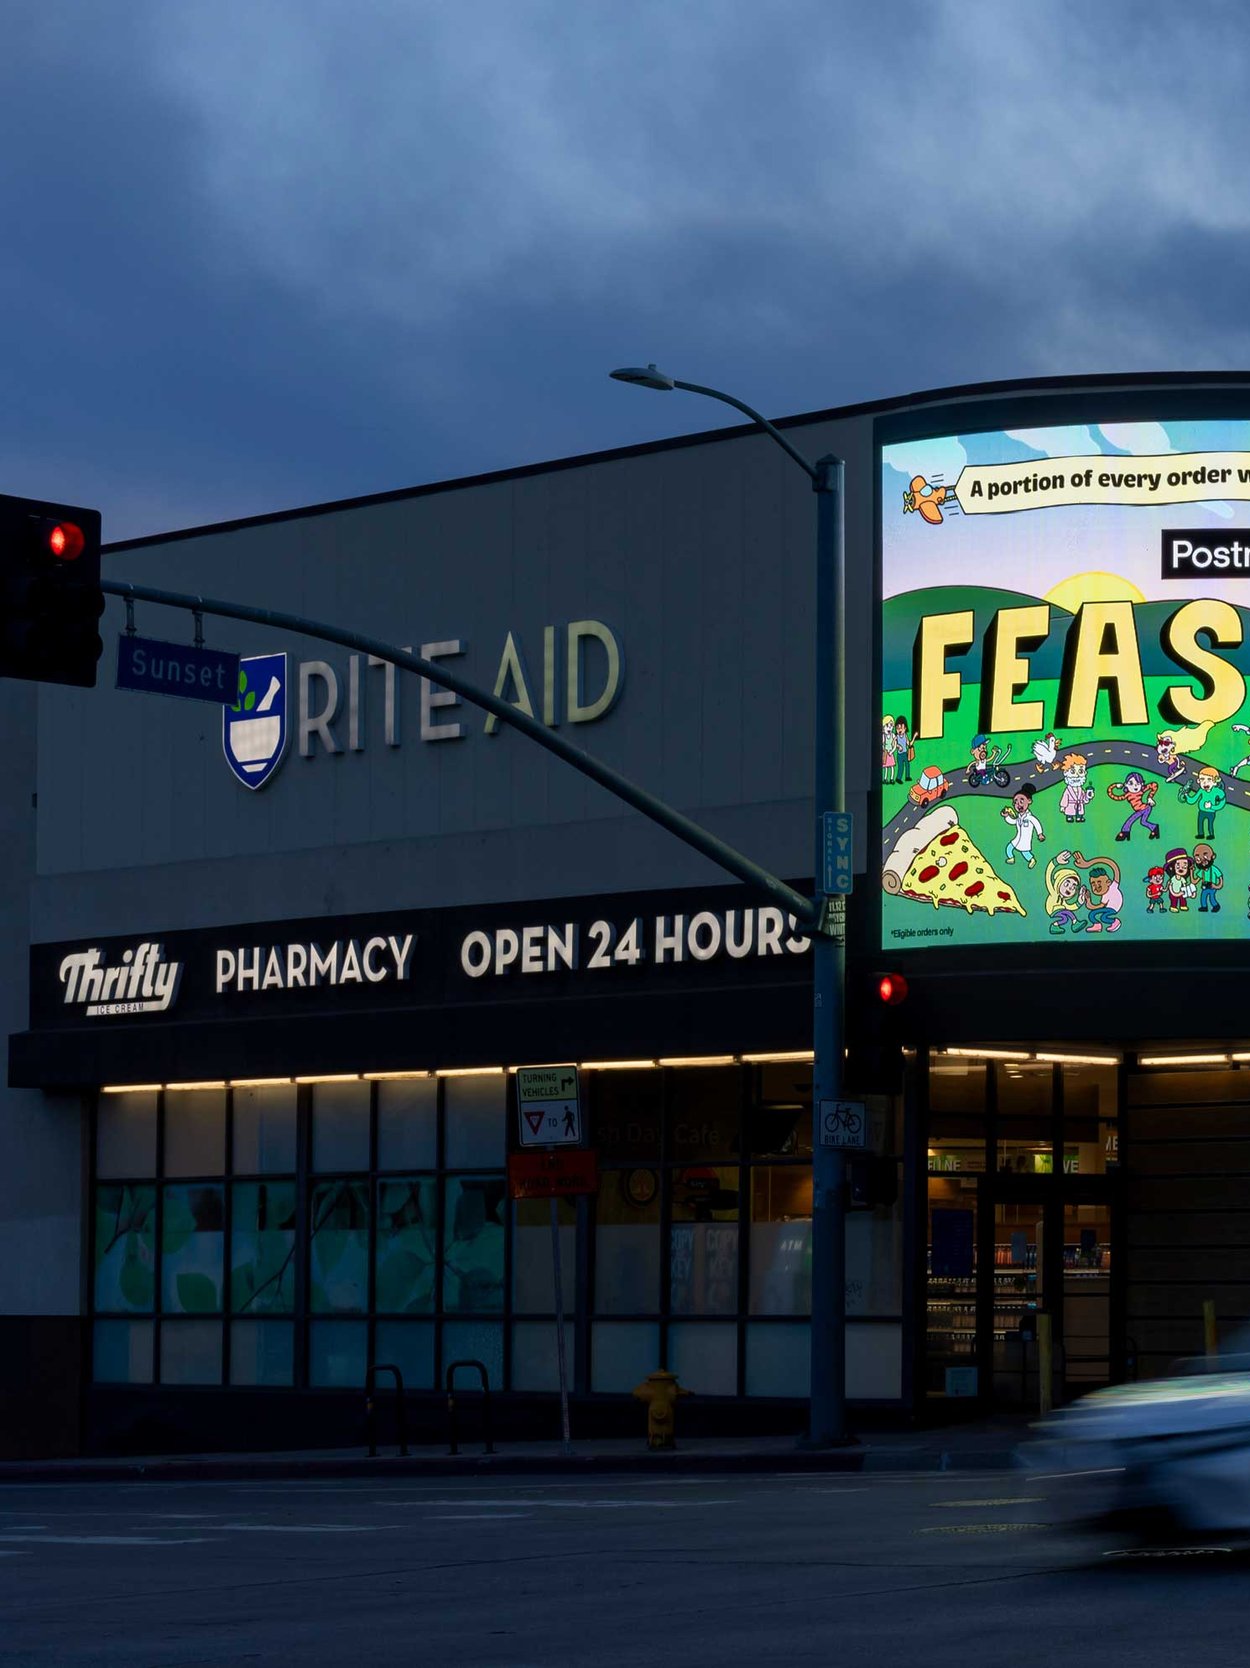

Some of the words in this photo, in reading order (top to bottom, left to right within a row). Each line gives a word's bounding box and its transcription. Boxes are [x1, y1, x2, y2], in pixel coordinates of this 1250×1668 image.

[970, 480, 983, 497] A
[988, 473, 1065, 500] portion
[1070, 469, 1093, 487] of
[1098, 473, 1161, 491] every
[1167, 466, 1232, 486] order
[131, 649, 227, 690] Sunset
[301, 640, 465, 757] RITE
[485, 621, 622, 735] AID
[836, 818, 849, 889] SYNC
[917, 928, 938, 936] orders
[939, 926, 955, 937] only
[215, 933, 414, 993] PHARMACY
[460, 922, 574, 978] OPEN
[587, 917, 641, 969] 24
[655, 906, 812, 963] HOURS
[60, 942, 179, 1012] Thrifty
[96, 1005, 111, 1015] ICE
[114, 1002, 145, 1014] CREAM
[522, 1072, 557, 1083] TURNING
[522, 1087, 560, 1098] VEHICLES
[548, 1118, 558, 1127] TO
[842, 1135, 861, 1145] LANE
